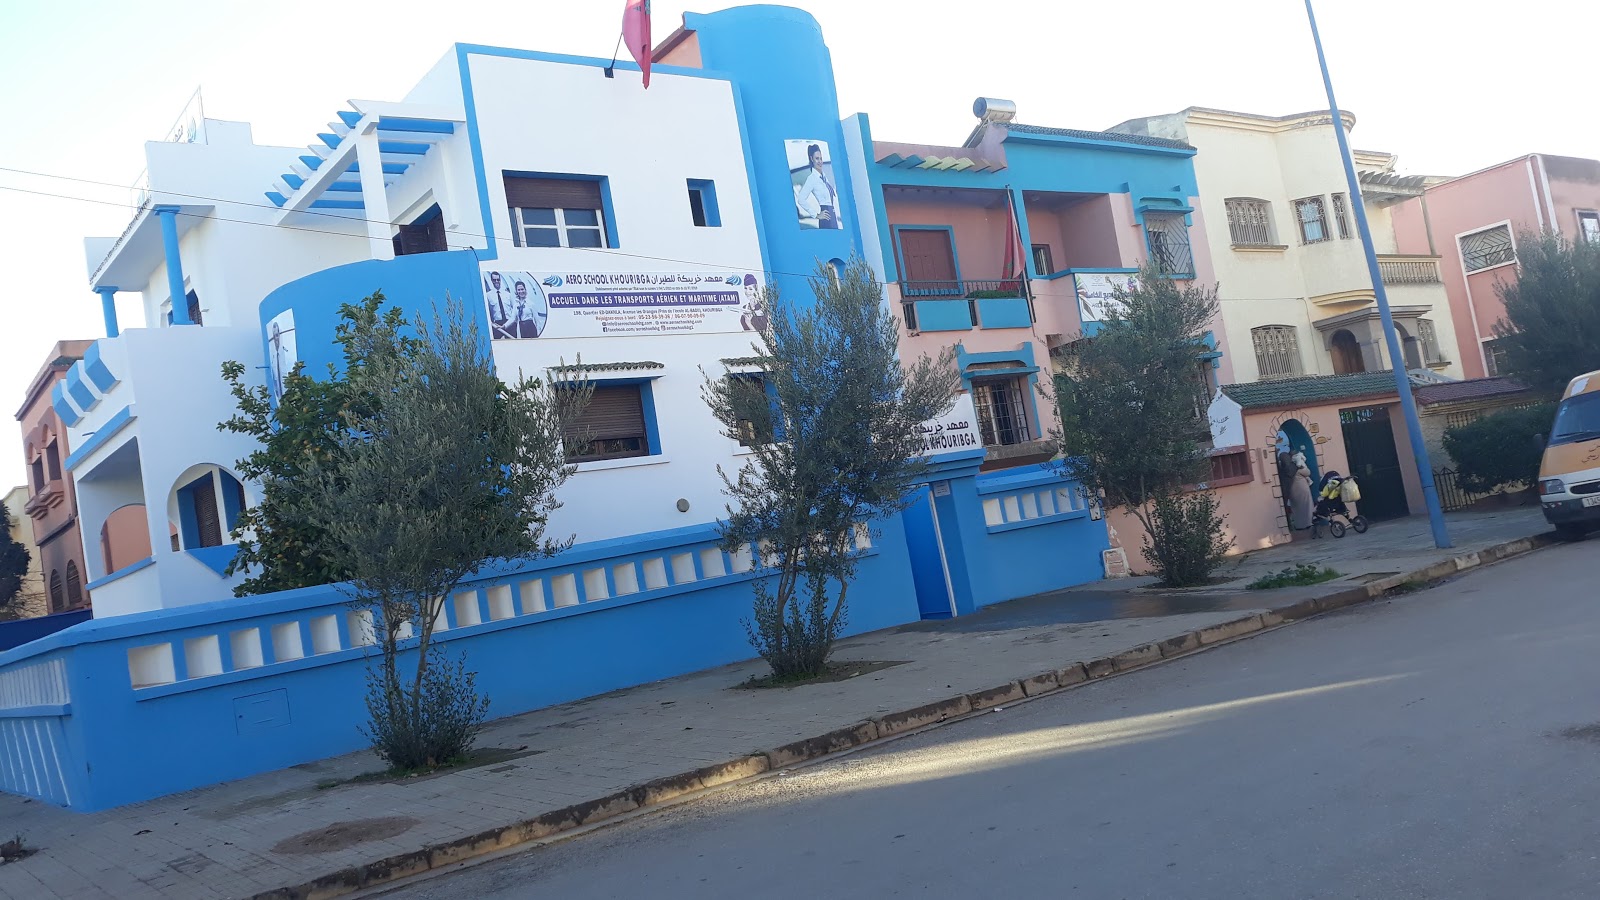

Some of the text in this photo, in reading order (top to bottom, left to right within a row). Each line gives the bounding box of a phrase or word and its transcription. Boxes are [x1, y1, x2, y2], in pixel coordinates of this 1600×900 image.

[565, 274, 651, 285] AERO SCHOOL KHOURIBGA
[651, 273, 723, 285] معهد خريبكة للطيران
[551, 293, 738, 305] ACCUEIL DANS LES TRANSPORTS AÉRIEN ET MARITIME (ATAM)
[946, 420, 969, 431] معهد
[929, 432, 977, 450] KHOURIBGA
